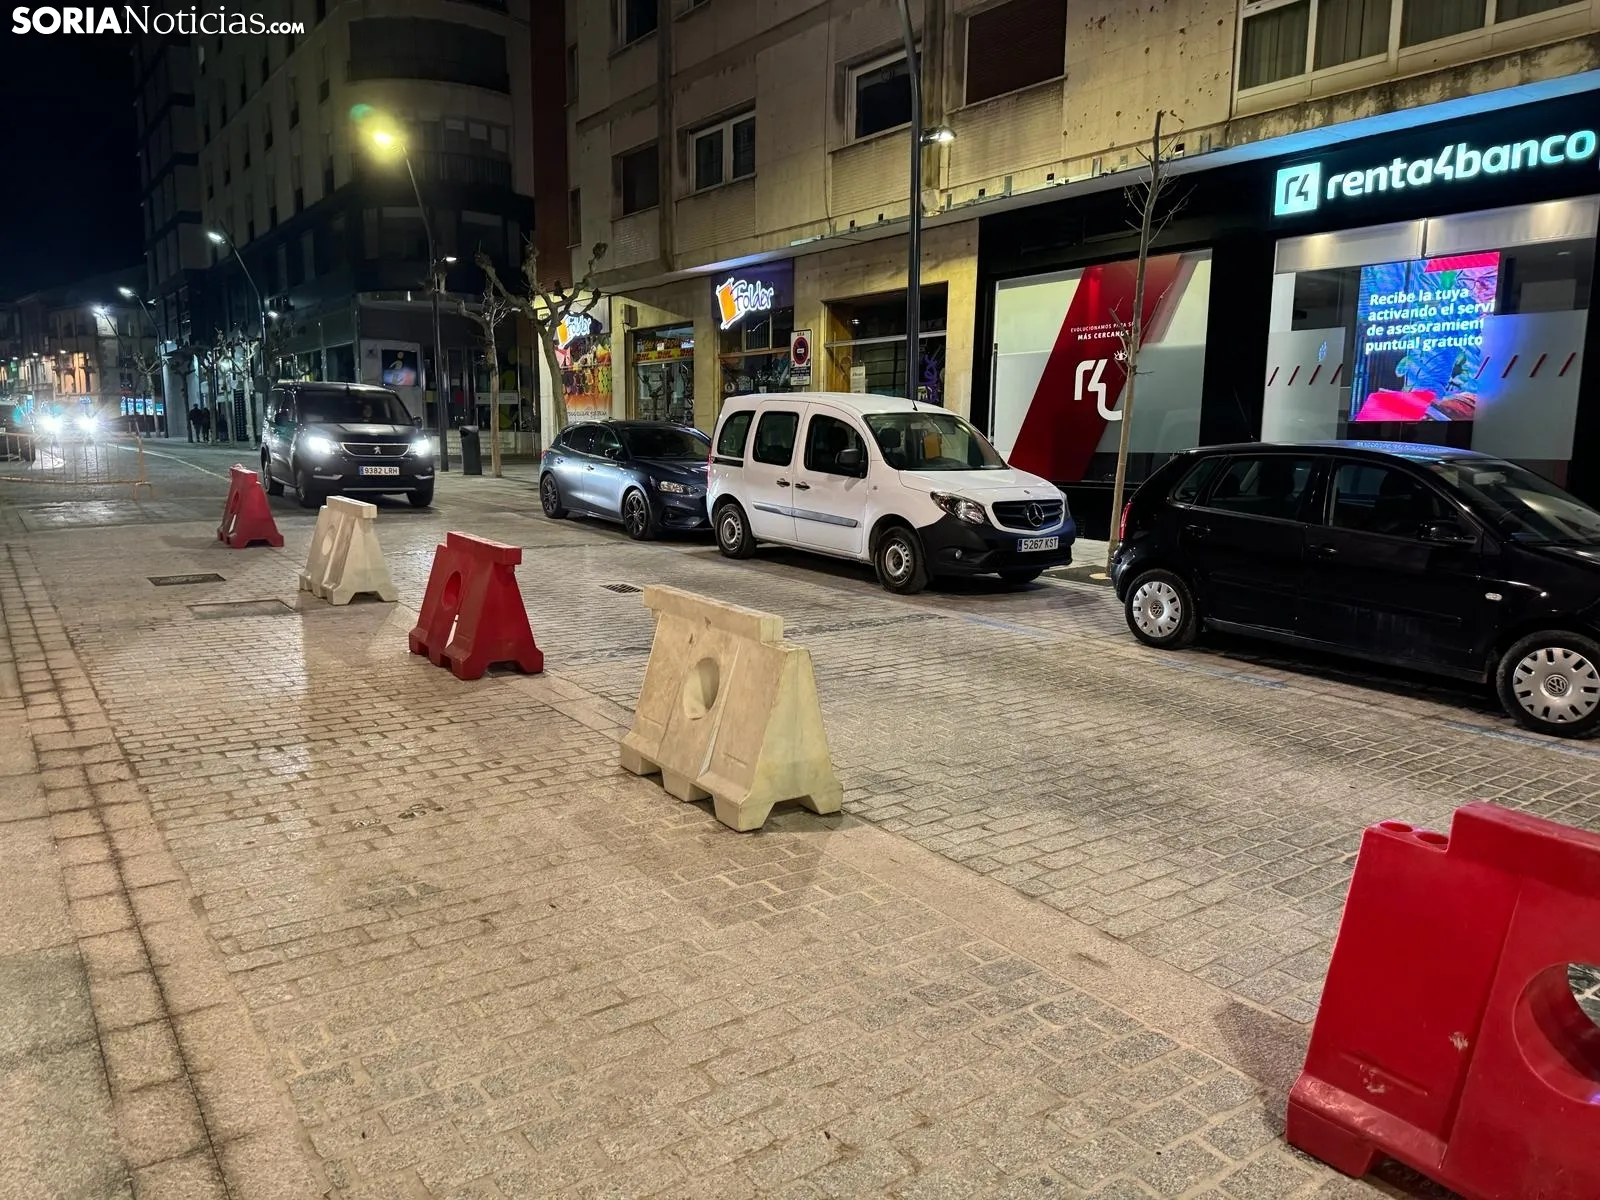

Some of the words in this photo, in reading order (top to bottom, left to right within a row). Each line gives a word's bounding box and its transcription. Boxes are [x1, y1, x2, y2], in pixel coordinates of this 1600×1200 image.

[1326, 129, 1596, 200] renta4banco
[730, 279, 774, 312] Folder
[1370, 290, 1416, 306] Recibe
[1418, 289, 1432, 302] la
[1435, 287, 1469, 303] tuya
[1368, 305, 1437, 321] activando
[1441, 303, 1455, 315] el
[1070, 323, 1112, 333] EVOLUCIONAMOS
[1366, 324, 1384, 336] de
[1077, 332, 1092, 341] MÁS
[1365, 337, 1420, 355] puntual
[1422, 334, 1483, 352] gratuito
[364, 467, 382, 475] 9382
[383, 467, 398, 475] LRH
[1023, 539, 1044, 550] 5267
[1044, 537, 1058, 549] KST
